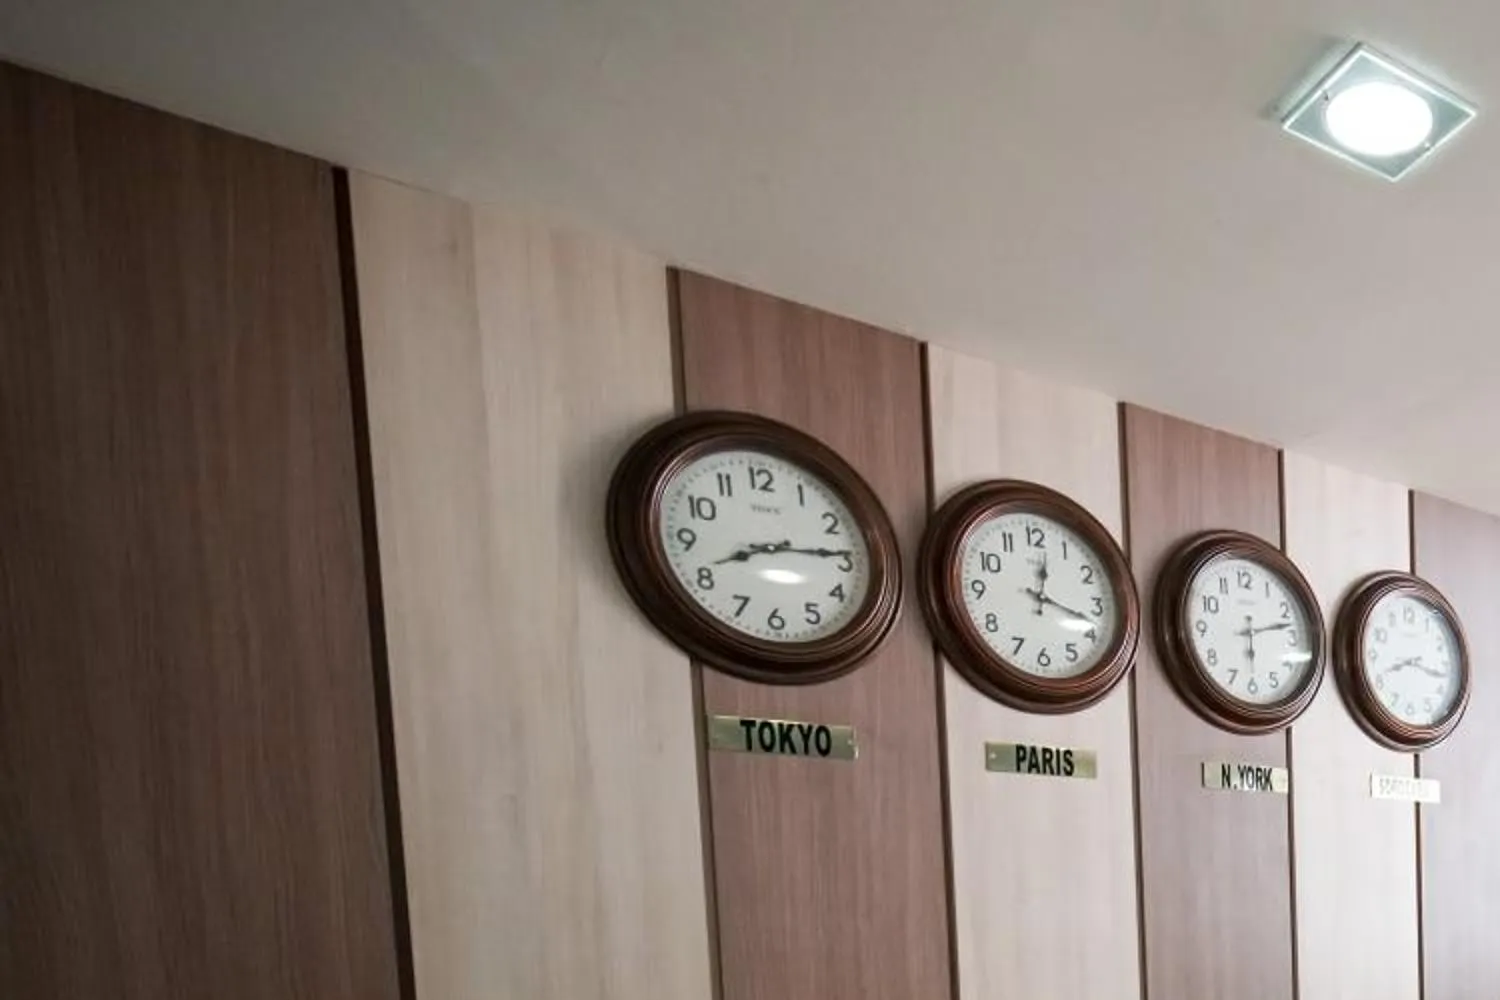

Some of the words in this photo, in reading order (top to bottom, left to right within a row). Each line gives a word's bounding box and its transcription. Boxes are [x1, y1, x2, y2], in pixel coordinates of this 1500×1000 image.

[717, 473, 733, 497] 11
[748, 467, 775, 492] 12
[797, 484, 805, 506] 1
[688, 495, 717, 521] 10
[822, 513, 839, 535] 2
[676, 528, 697, 550] 9
[1002, 532, 1013, 552] 11
[1025, 526, 1046, 548] 12
[1061, 541, 1068, 560] 1
[838, 550, 853, 572] 3
[980, 552, 1001, 573] 10
[696, 567, 715, 590] 8
[1080, 565, 1094, 585] 2
[1237, 571, 1252, 590] 12
[829, 583, 845, 602] 4
[971, 579, 986, 600] 9
[1219, 578, 1228, 595] 11
[1265, 582, 1271, 598] 1
[732, 594, 750, 618] 7
[805, 603, 821, 625] 5
[1091, 597, 1103, 616] 3
[1202, 595, 1219, 615] 10
[1279, 601, 1290, 619] 2
[767, 608, 786, 630] 6
[985, 613, 999, 633] 8
[1196, 620, 1207, 638] 9
[1084, 628, 1097, 643] 4
[1012, 637, 1024, 656] 7
[1065, 643, 1078, 662] 5
[1037, 647, 1051, 667] 6
[1207, 649, 1217, 666] 8
[1227, 669, 1238, 685] 7
[1247, 677, 1258, 694] 6
[1268, 672, 1279, 689] 5
[739, 720, 832, 757] TOKYO
[1015, 744, 1075, 777] PARIS
[1221, 763, 1273, 791] N.YORK
